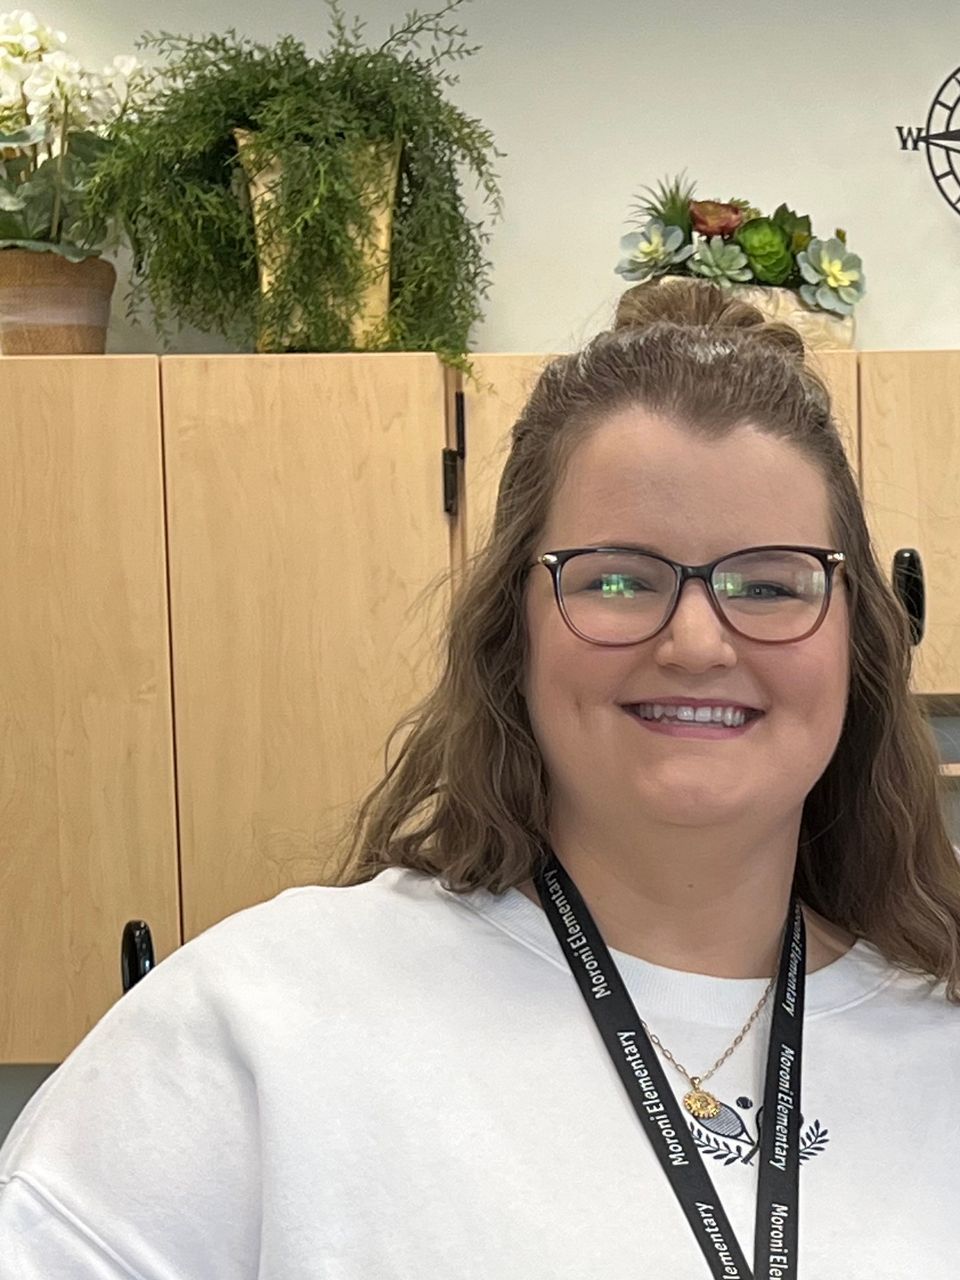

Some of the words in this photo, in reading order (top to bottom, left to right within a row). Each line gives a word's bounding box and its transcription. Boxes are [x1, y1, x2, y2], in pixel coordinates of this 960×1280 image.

[896, 126, 925, 151] W
[544, 869, 588, 950] Elementary
[573, 946, 612, 999] Moroni
[616, 1031, 665, 1114] Elementary
[779, 1043, 796, 1096] Moroni
[649, 1114, 690, 1166] Moroni
[769, 1092, 794, 1171] Elementary
[769, 1203, 789, 1253] Moroni
